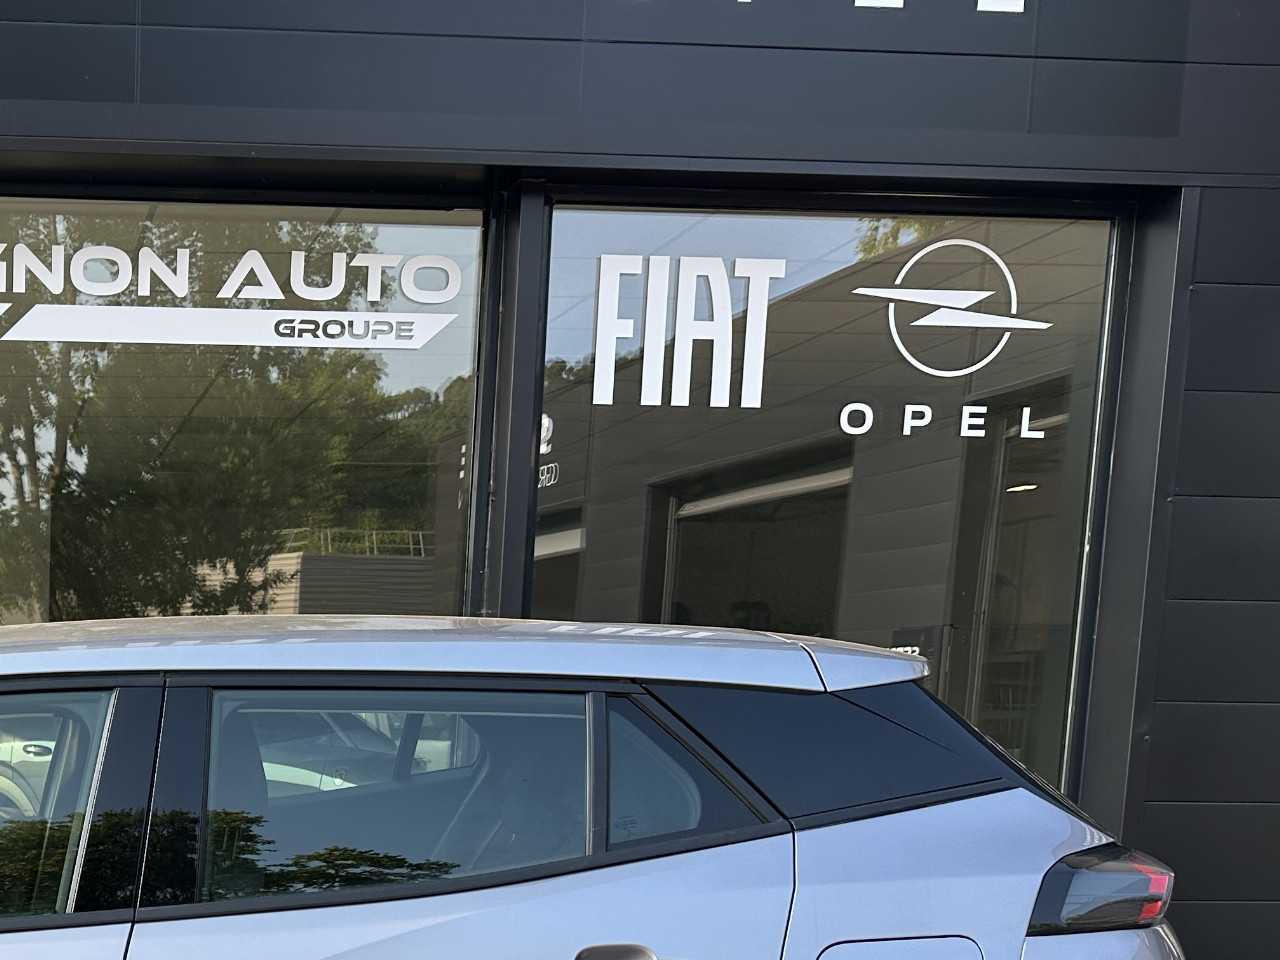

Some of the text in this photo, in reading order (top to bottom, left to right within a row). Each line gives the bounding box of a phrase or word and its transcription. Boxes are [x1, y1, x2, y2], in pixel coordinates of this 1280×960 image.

[216, 249, 462, 304] AUTO
[273, 318, 415, 341] GROUPE
[592, 254, 786, 408] FIAT
[839, 402, 1045, 438] OPEL
